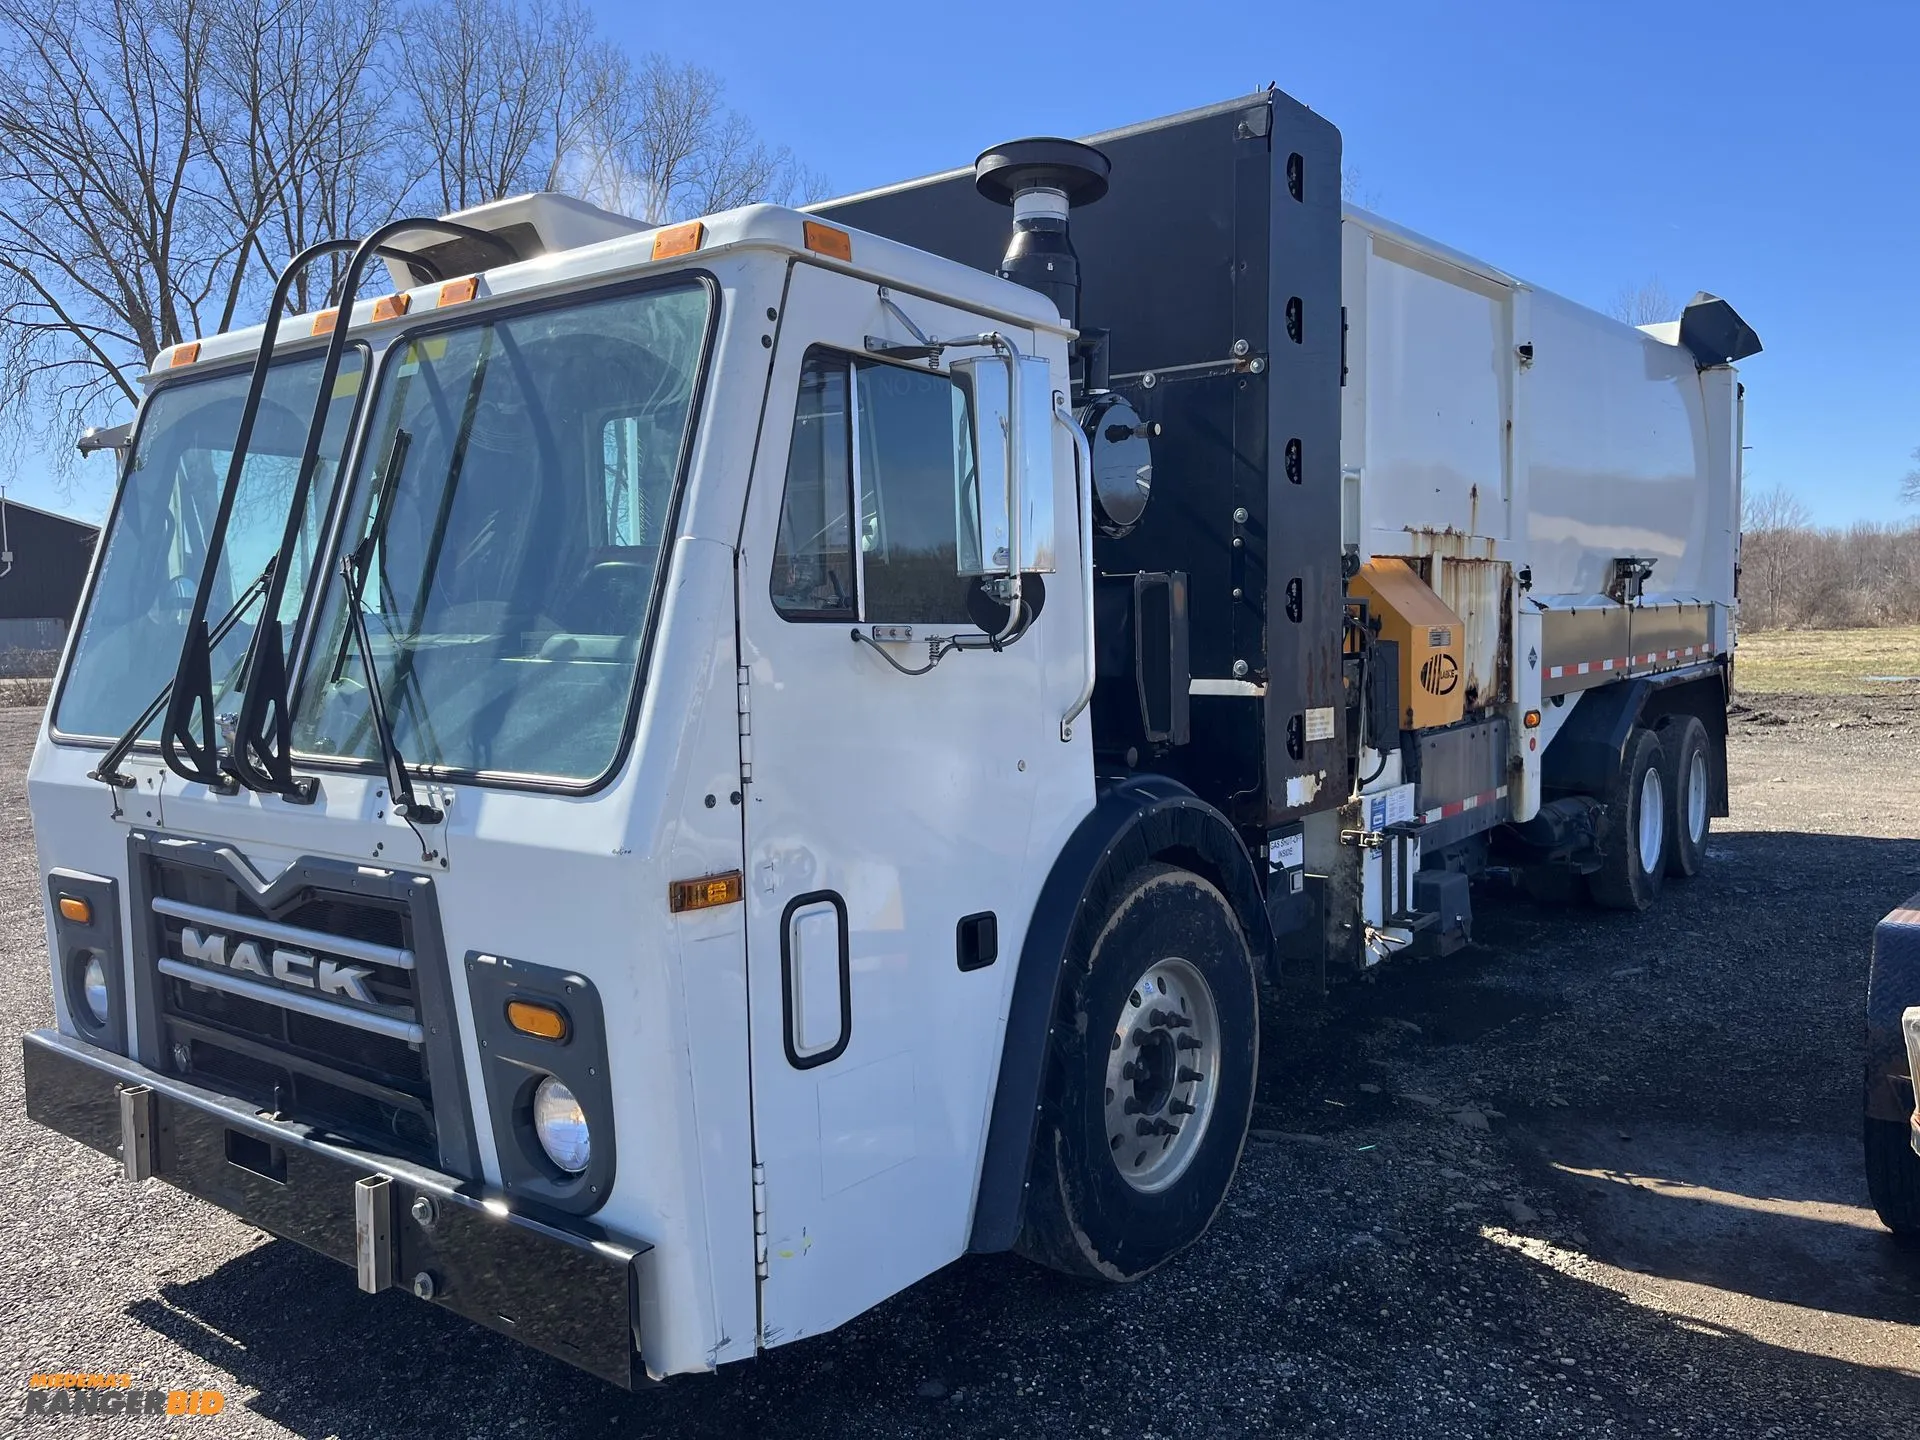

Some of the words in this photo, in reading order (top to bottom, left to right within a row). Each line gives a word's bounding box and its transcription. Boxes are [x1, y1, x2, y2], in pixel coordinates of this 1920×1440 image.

[1270, 840, 1280, 850] GAS
[1278, 847, 1293, 858] INSIDE
[181, 926, 378, 1004] MACK
